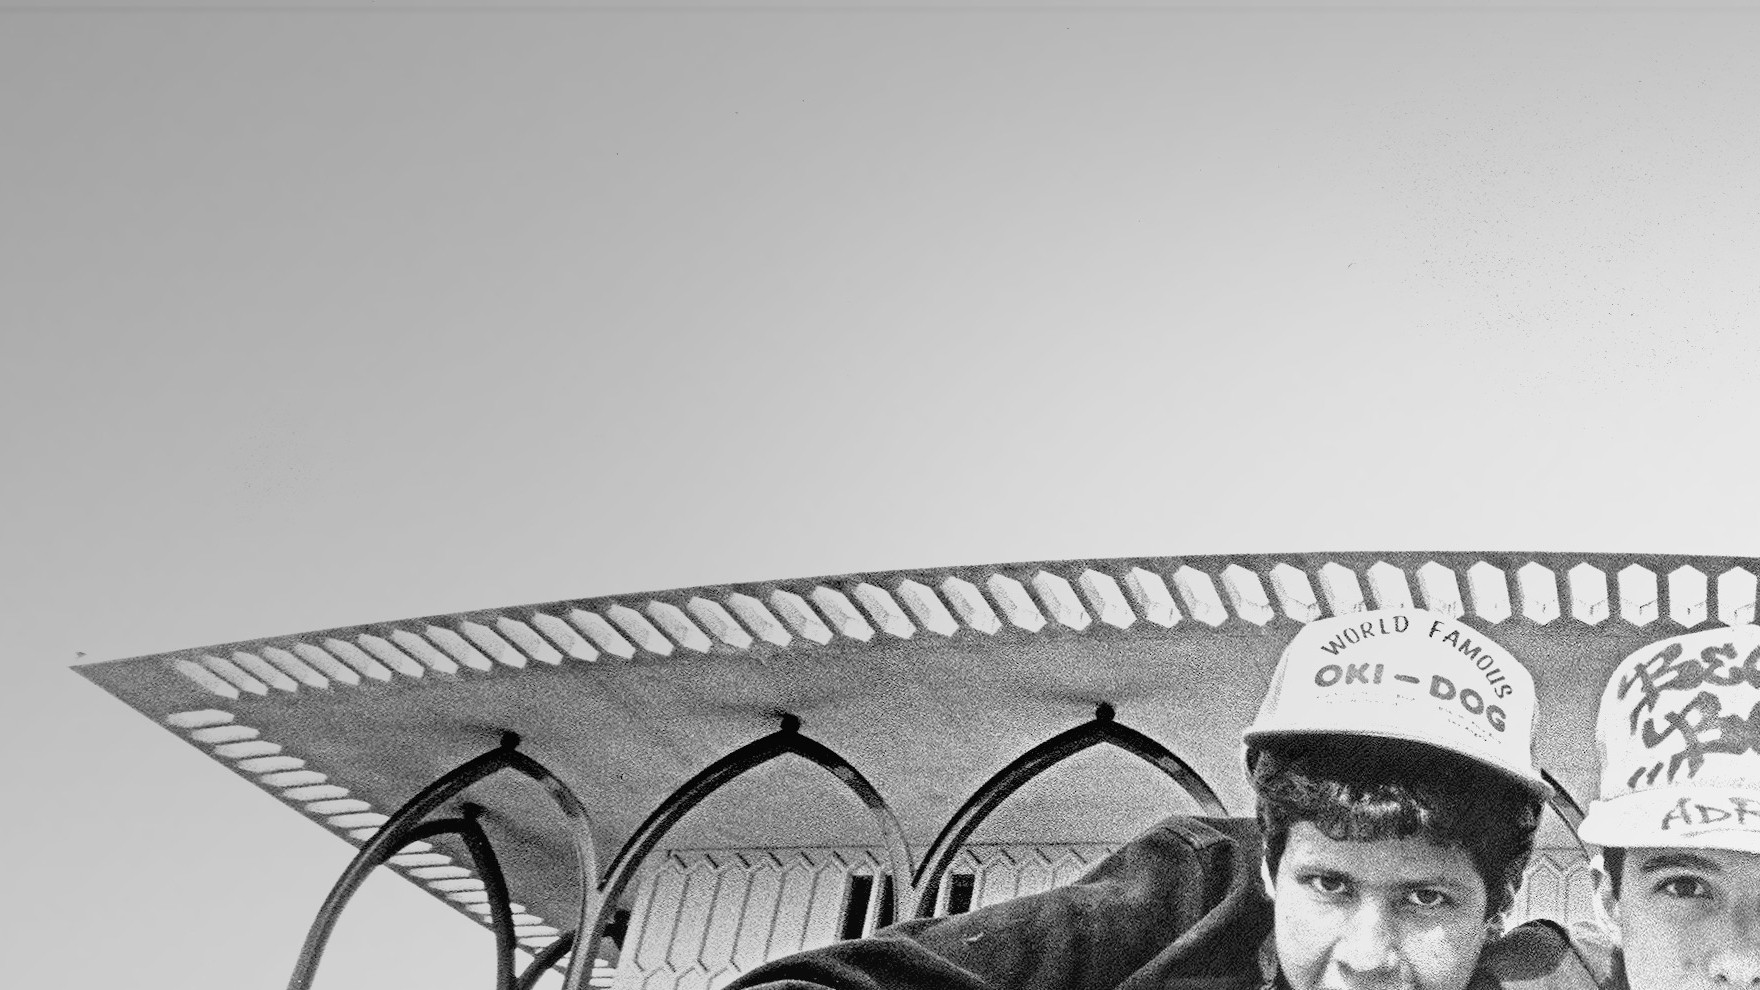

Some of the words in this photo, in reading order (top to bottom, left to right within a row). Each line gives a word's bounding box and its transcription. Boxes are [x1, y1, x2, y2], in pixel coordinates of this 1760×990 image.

[1321, 615, 1409, 656] WORLD
[1428, 620, 1513, 699] FAMOUS
[1314, 663, 1384, 687] OKI
[1429, 674, 1506, 732] DOG
